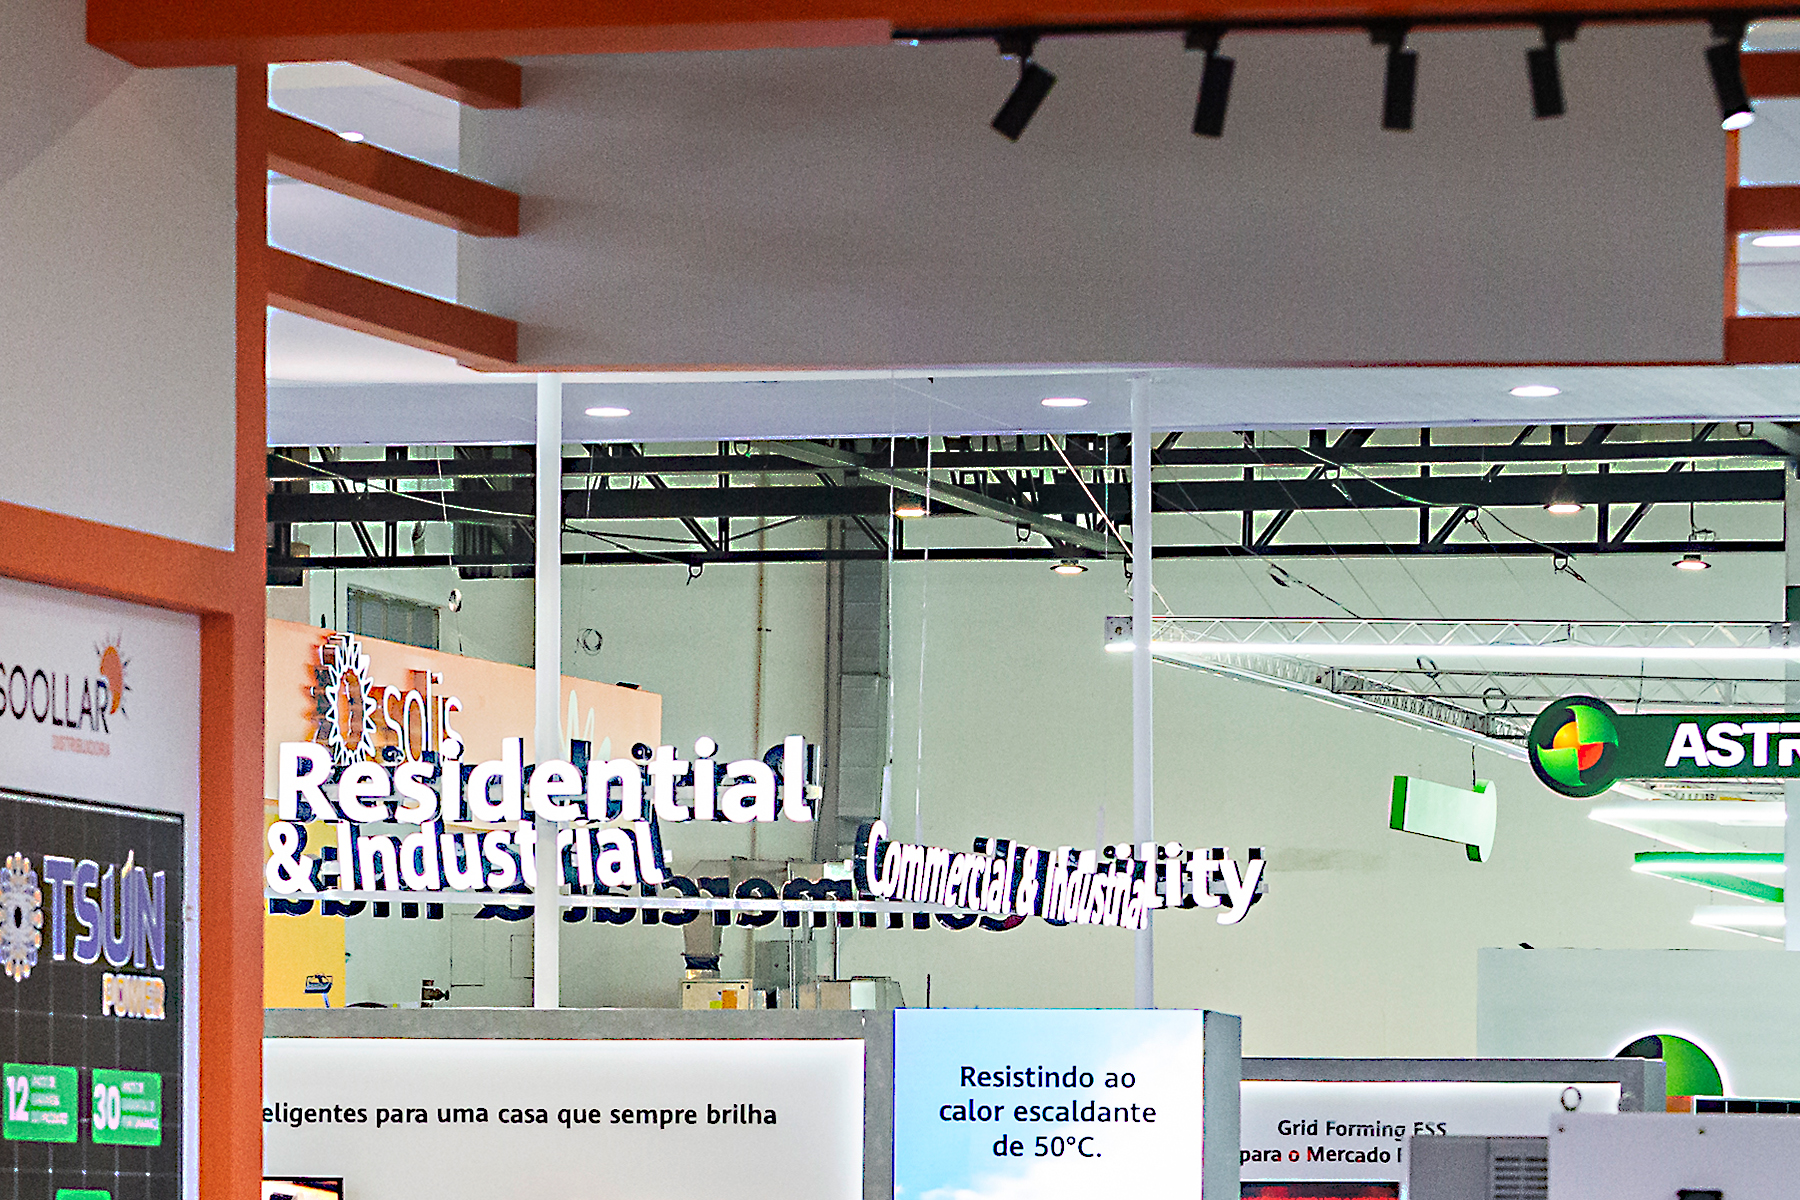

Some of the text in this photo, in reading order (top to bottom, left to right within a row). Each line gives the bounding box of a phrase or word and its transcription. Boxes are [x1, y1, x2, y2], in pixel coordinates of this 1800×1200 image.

[383, 669, 464, 764] solis
[278, 735, 815, 824] Residential
[265, 820, 666, 895] & Industrial
[866, 819, 1017, 914] Commercial
[1016, 845, 1040, 917] &
[43, 850, 166, 971] TSUN
[102, 972, 166, 1020] POWER
[6, 1075, 30, 1122] 12
[960, 1065, 1136, 1089] Resistindo ao
[93, 1083, 121, 1130] 30
[262, 1102, 777, 1130] eligentes para uma casa que sempre brilha
[939, 1098, 1157, 1123] calor escaldante
[992, 1133, 1102, 1158] de 50°C.
[1277, 1119, 1447, 1142] Grid Forming ESS
[1240, 1148, 1282, 1167] para
[1288, 1149, 1300, 1163] o
[1306, 1145, 1391, 1164] Mercado
